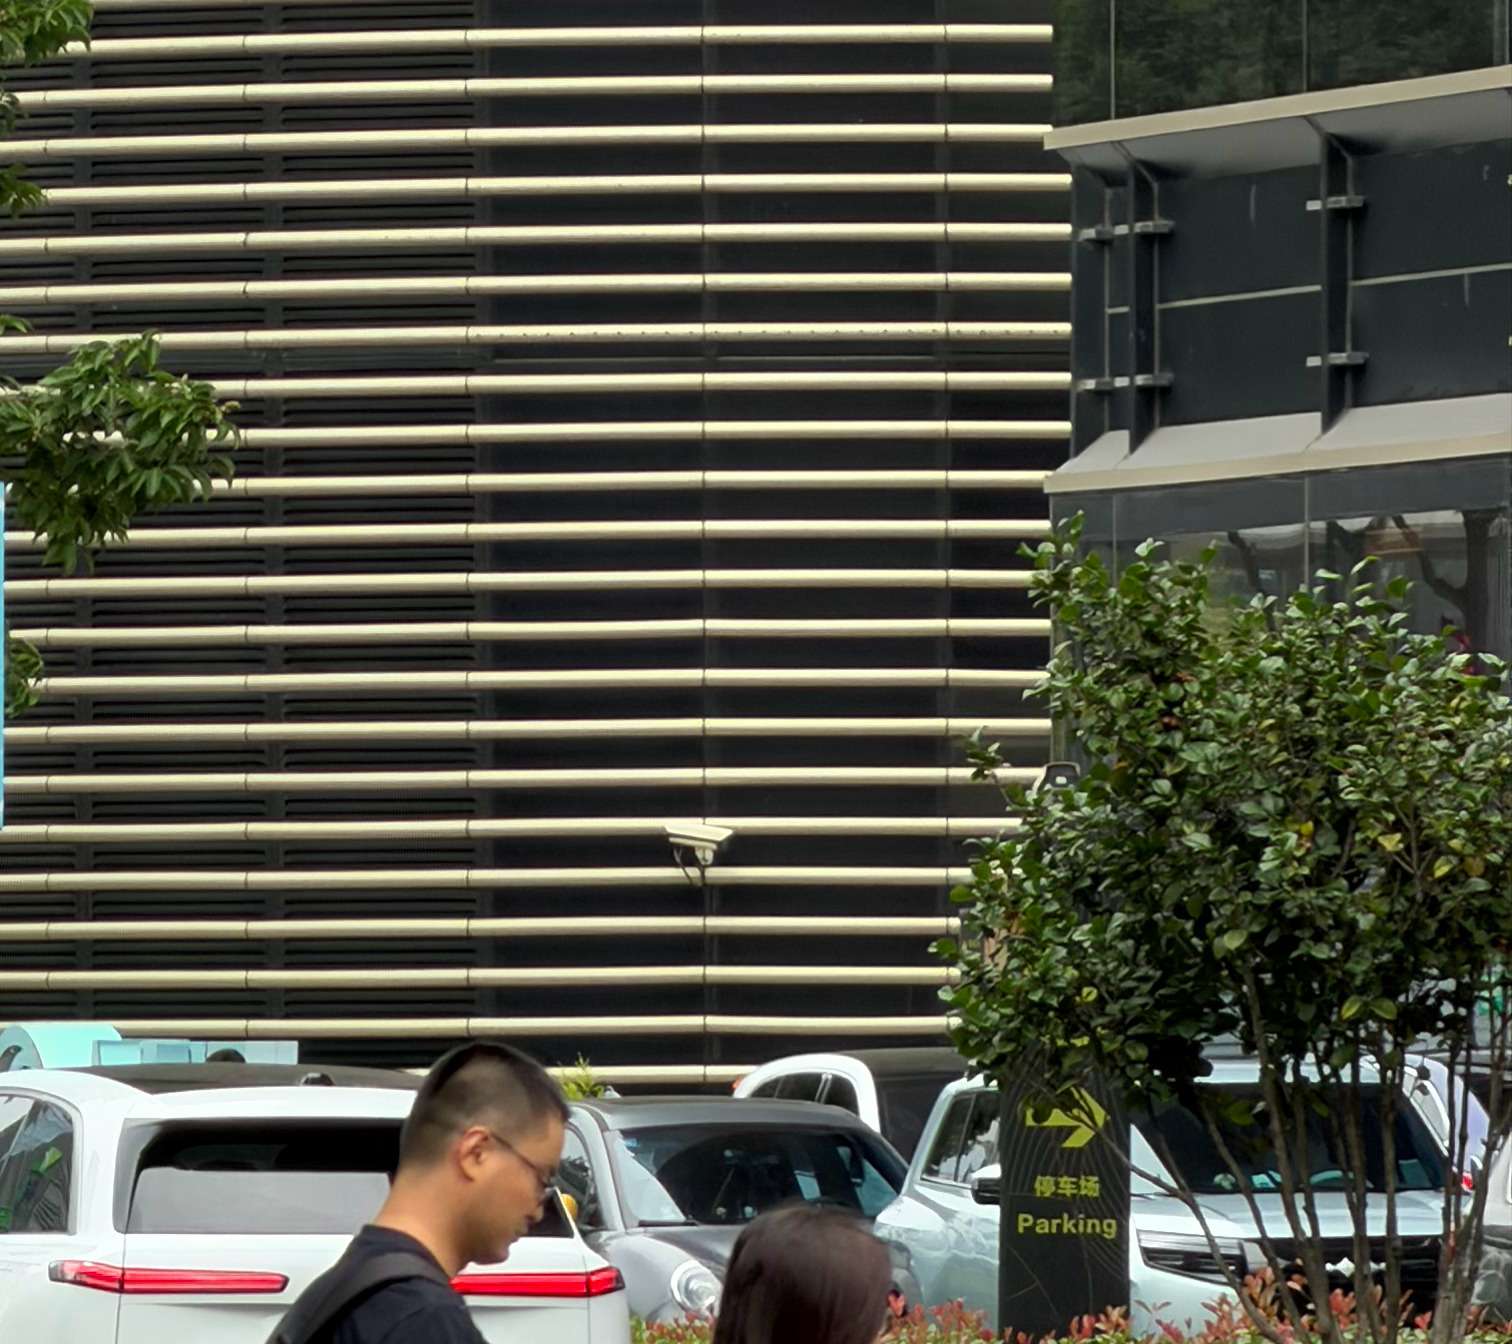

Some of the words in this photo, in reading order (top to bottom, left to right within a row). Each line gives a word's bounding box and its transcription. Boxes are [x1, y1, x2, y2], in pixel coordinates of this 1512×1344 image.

[1033, 1175, 1100, 1198] 停车场
[1017, 1213, 1118, 1239] Parking
